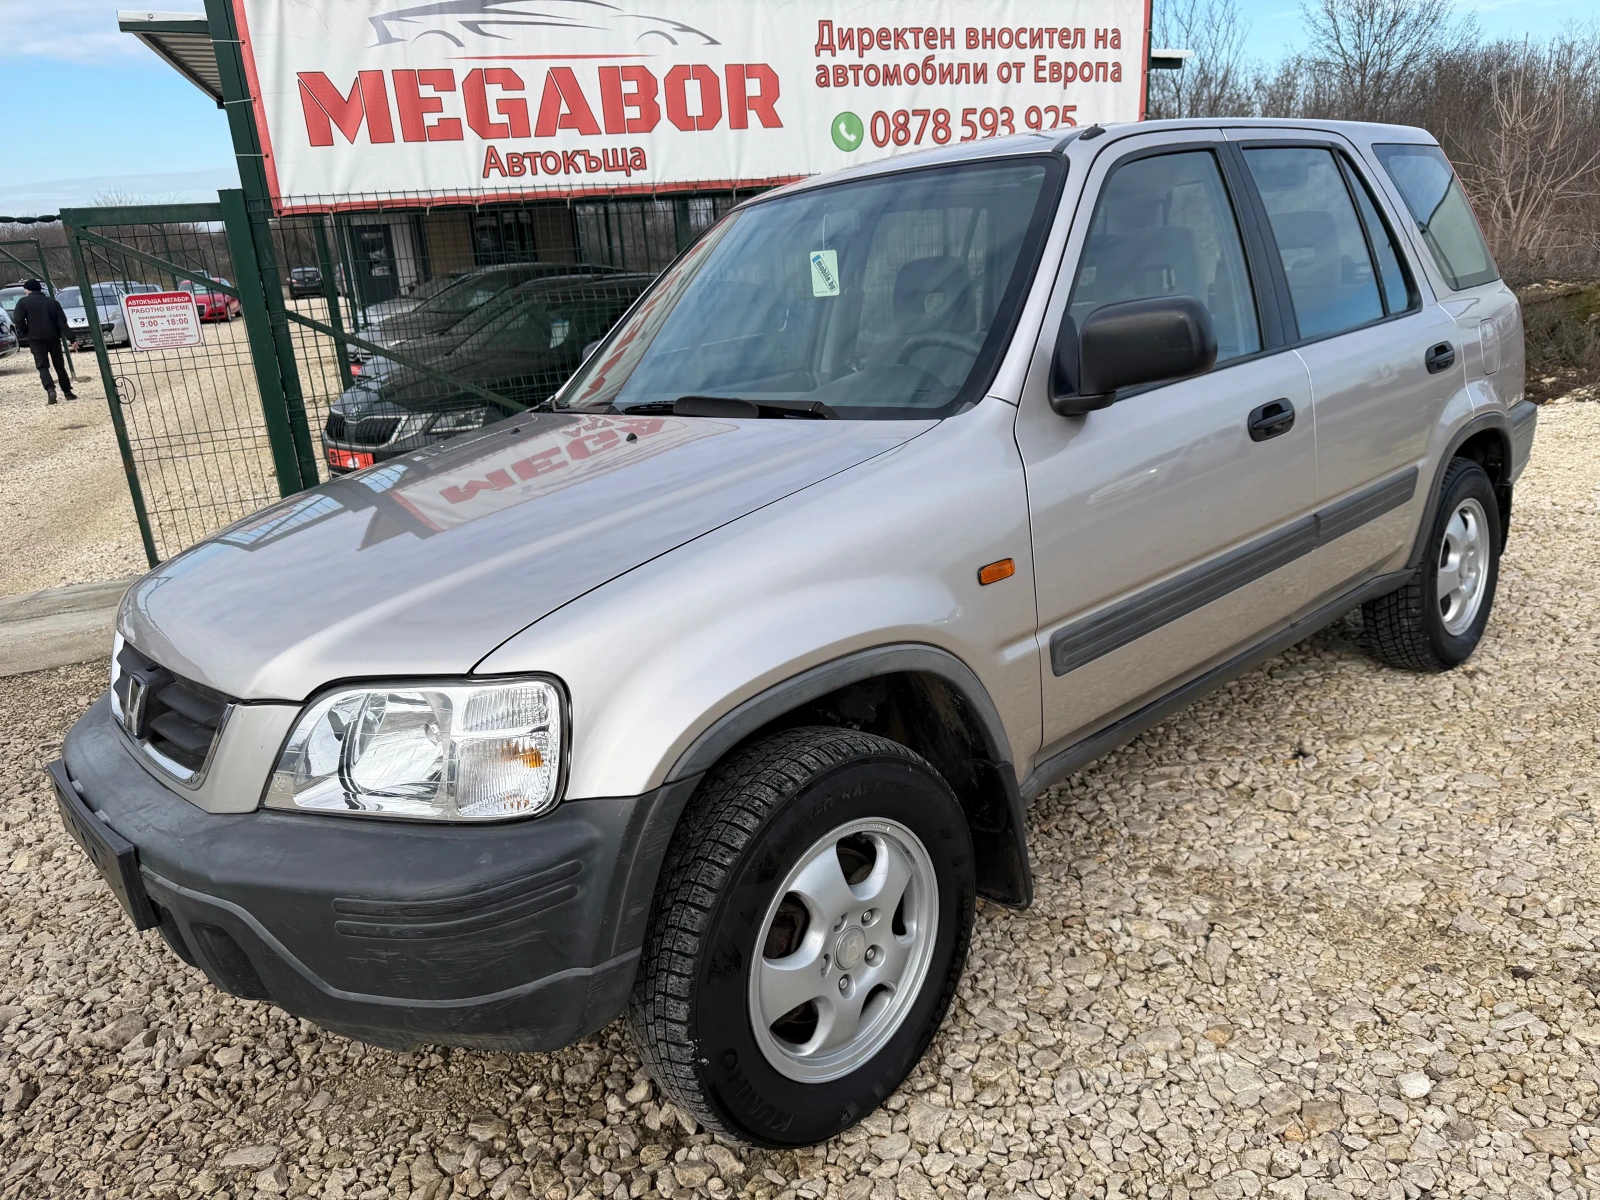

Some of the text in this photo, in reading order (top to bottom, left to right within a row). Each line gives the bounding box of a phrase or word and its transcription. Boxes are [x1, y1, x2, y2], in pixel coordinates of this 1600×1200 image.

[815, 20, 1122, 58] Директен вносител на
[815, 55, 1122, 89] автомобили от Европа
[297, 63, 783, 147] MEGABOR
[870, 105, 1077, 148] 0878 593 925
[483, 146, 647, 178] Автокъща
[128, 297, 162, 306] АВТОКЪЩА
[131, 306, 165, 314] РАБОТНО
[140, 320, 158, 328] 9:00
[166, 318, 189, 326] 18:00
[721, 1047, 794, 1132] KUMHO
